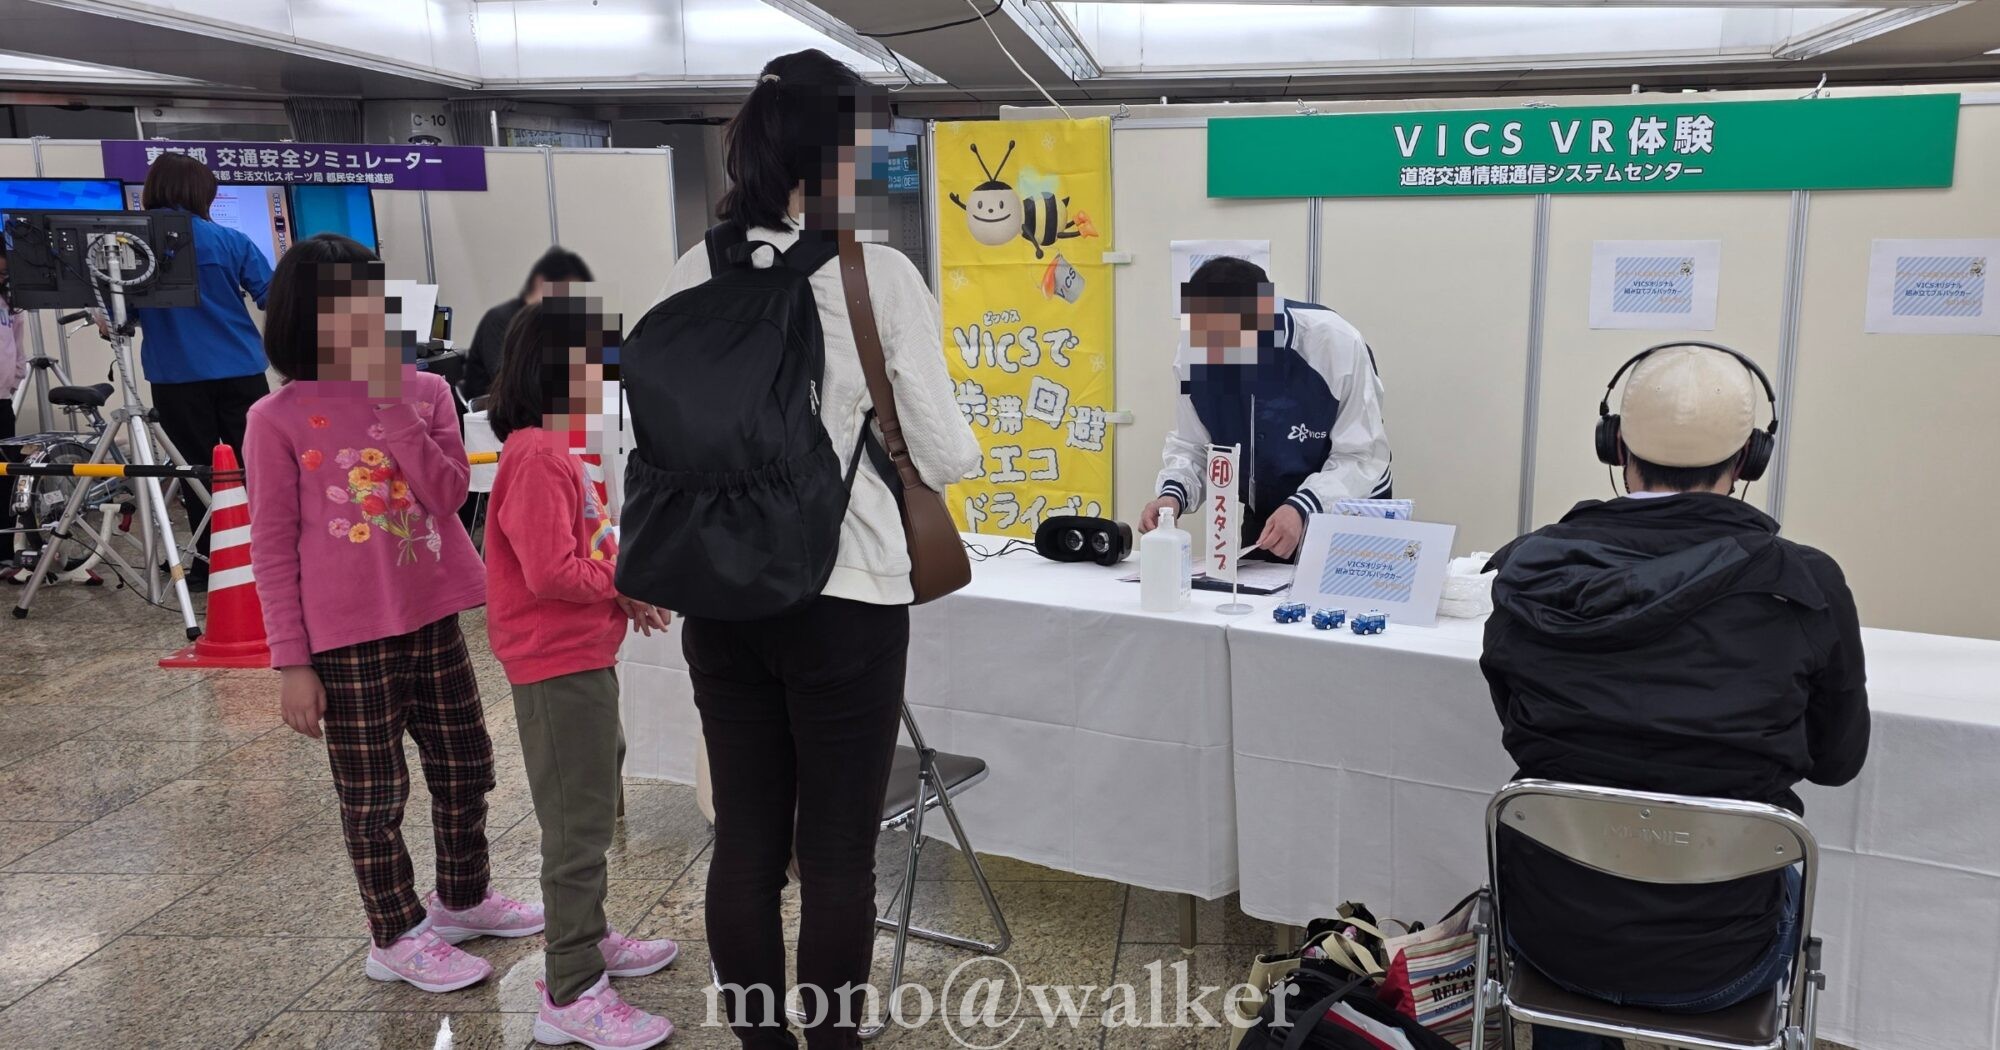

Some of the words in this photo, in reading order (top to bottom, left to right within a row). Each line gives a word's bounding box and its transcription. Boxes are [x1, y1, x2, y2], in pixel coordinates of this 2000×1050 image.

[412, 113, 447, 128] C-10
[1393, 120, 1524, 158] VICS
[217, 147, 444, 170] 交通安全シミュレーター
[233, 171, 324, 183] 生活文化スポーツ局
[326, 172, 395, 184] 都民安全推進部
[1399, 162, 1704, 188] 道路交通情報通信システムセンター
[1056, 267, 1077, 299] VICS
[982, 310, 1021, 327] ビックス
[953, 323, 1080, 374] VICSで
[1210, 459, 1231, 486] 印
[1213, 494, 1228, 572] スタンプ
[1346, 560, 1394, 571] VICSオリジナル
